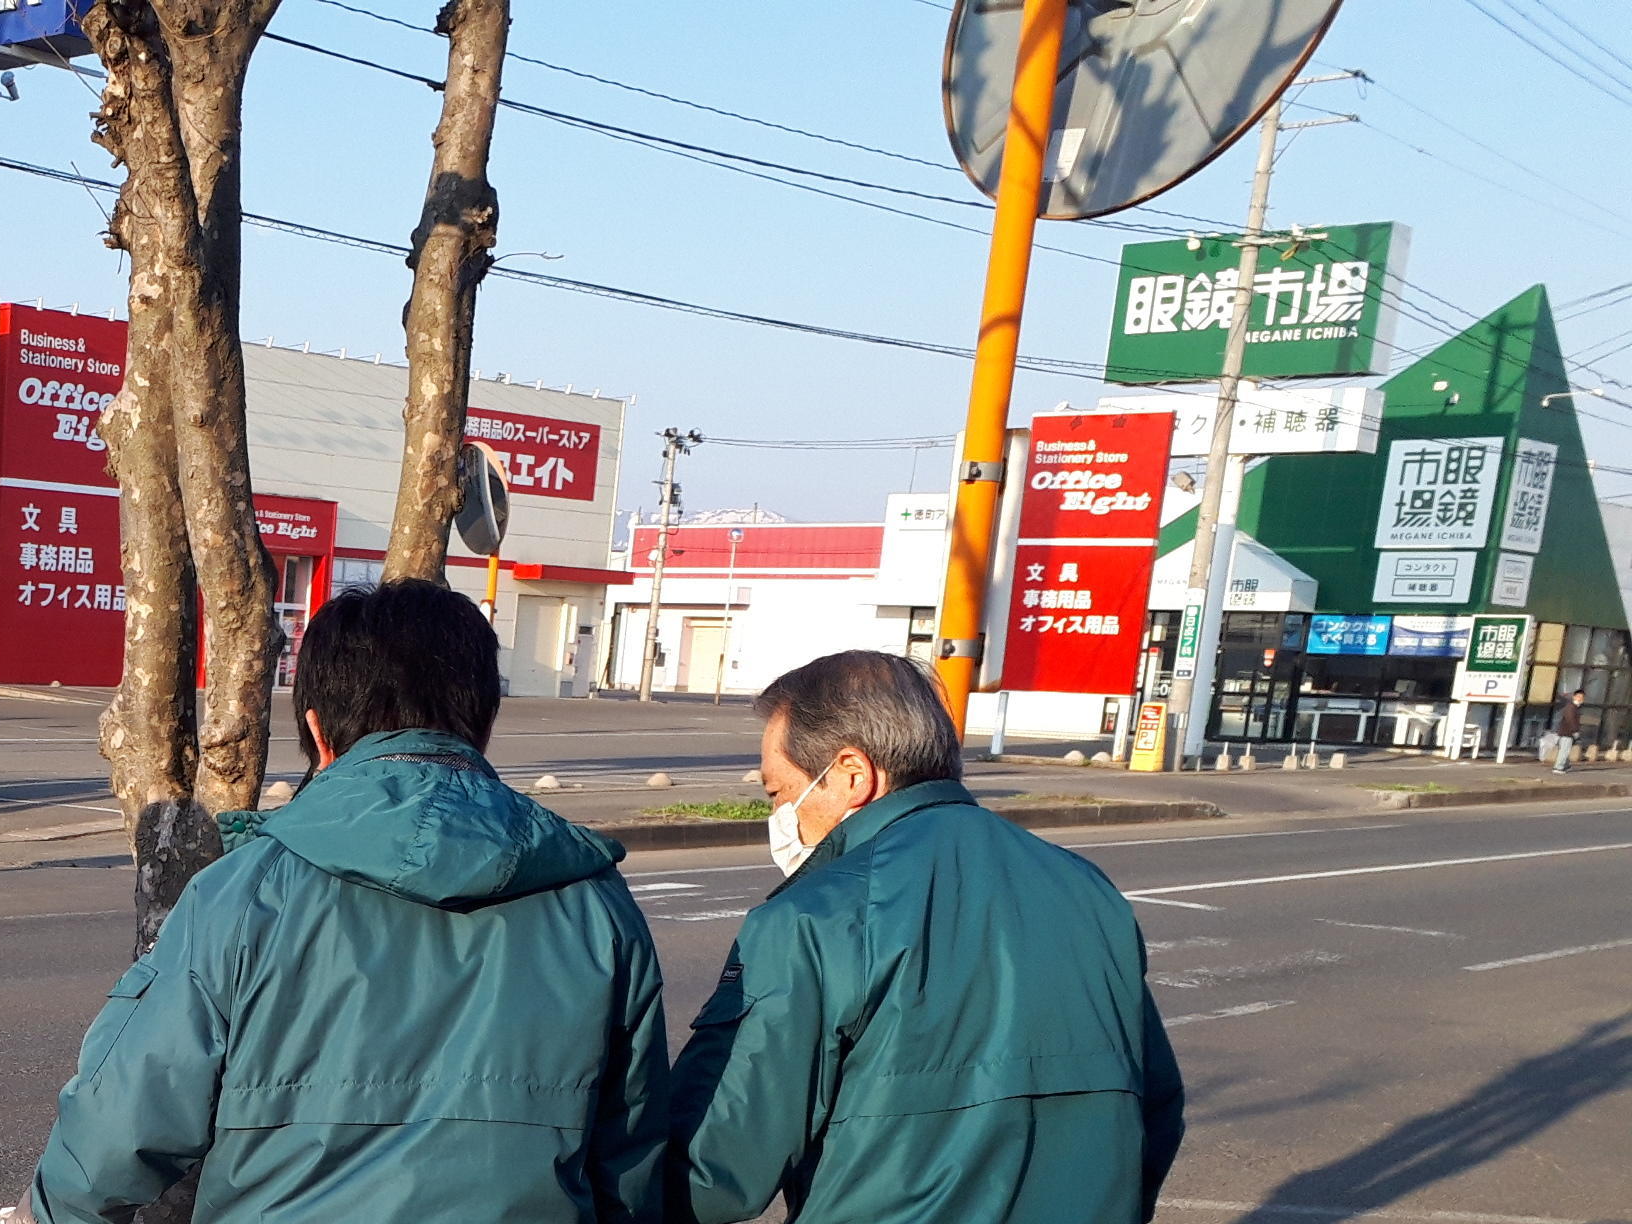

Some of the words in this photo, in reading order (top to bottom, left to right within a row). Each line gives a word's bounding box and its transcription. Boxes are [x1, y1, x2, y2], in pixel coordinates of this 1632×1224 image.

[1124, 261, 1369, 334] 眼鏡市場
[1306, 326, 1358, 340] ICHIBA
[20, 349, 84, 373] Stationery
[87, 358, 121, 376] Store
[53, 413, 107, 452] Eig
[1035, 453, 1093, 465] Stationery
[1095, 452, 1129, 464] Store
[1031, 471, 1122, 489] Office
[1060, 491, 1152, 515] Eight
[276, 522, 318, 540] Eight
[1390, 532, 1433, 541] MEGANE
[1437, 532, 1473, 540] ICHIBA
[19, 542, 94, 574] 事務用品
[1404, 563, 1448, 573] コンタクト
[18, 581, 126, 612] オフィス用品
[1023, 589, 1093, 610] 事務用品
[1020, 615, 1120, 636] オフィス用品
[1484, 679, 1499, 695] P
